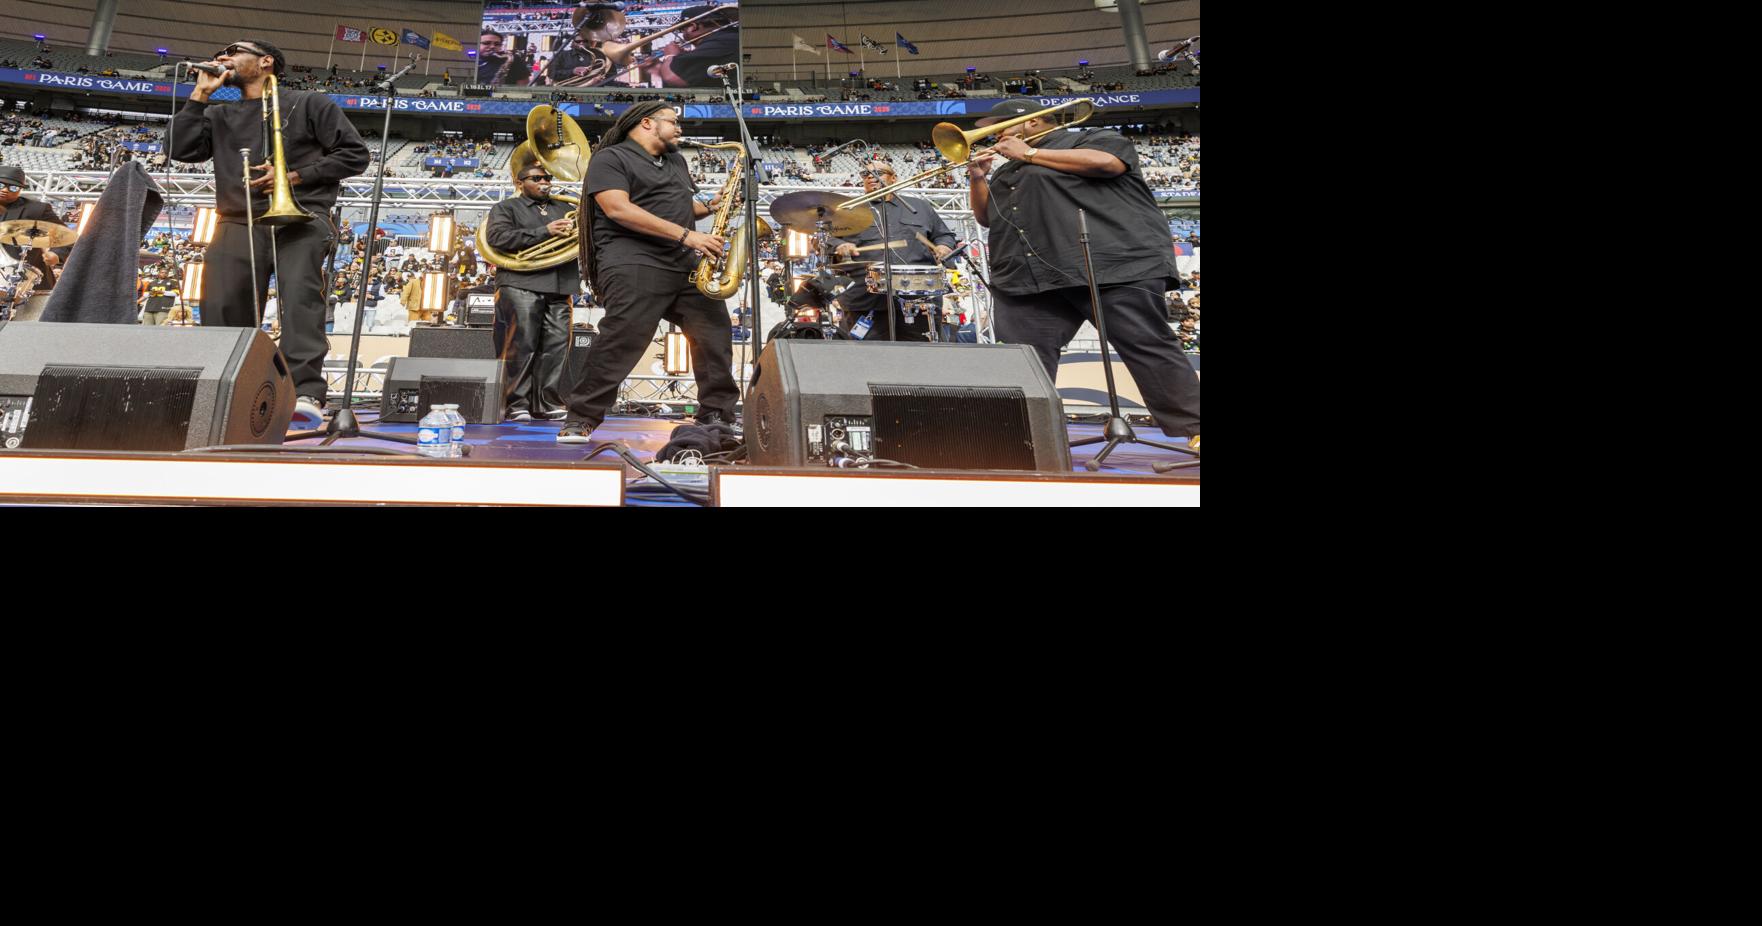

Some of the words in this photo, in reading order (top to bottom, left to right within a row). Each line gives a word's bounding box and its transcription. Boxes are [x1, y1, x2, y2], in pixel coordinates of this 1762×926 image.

[39, 73, 92, 87] PARIS
[96, 80, 153, 92] GAME
[411, 101, 464, 111] GAME
[1080, 95, 1139, 106] RANCE
[764, 106, 814, 116] PARIS
[816, 105, 872, 115] GAME
